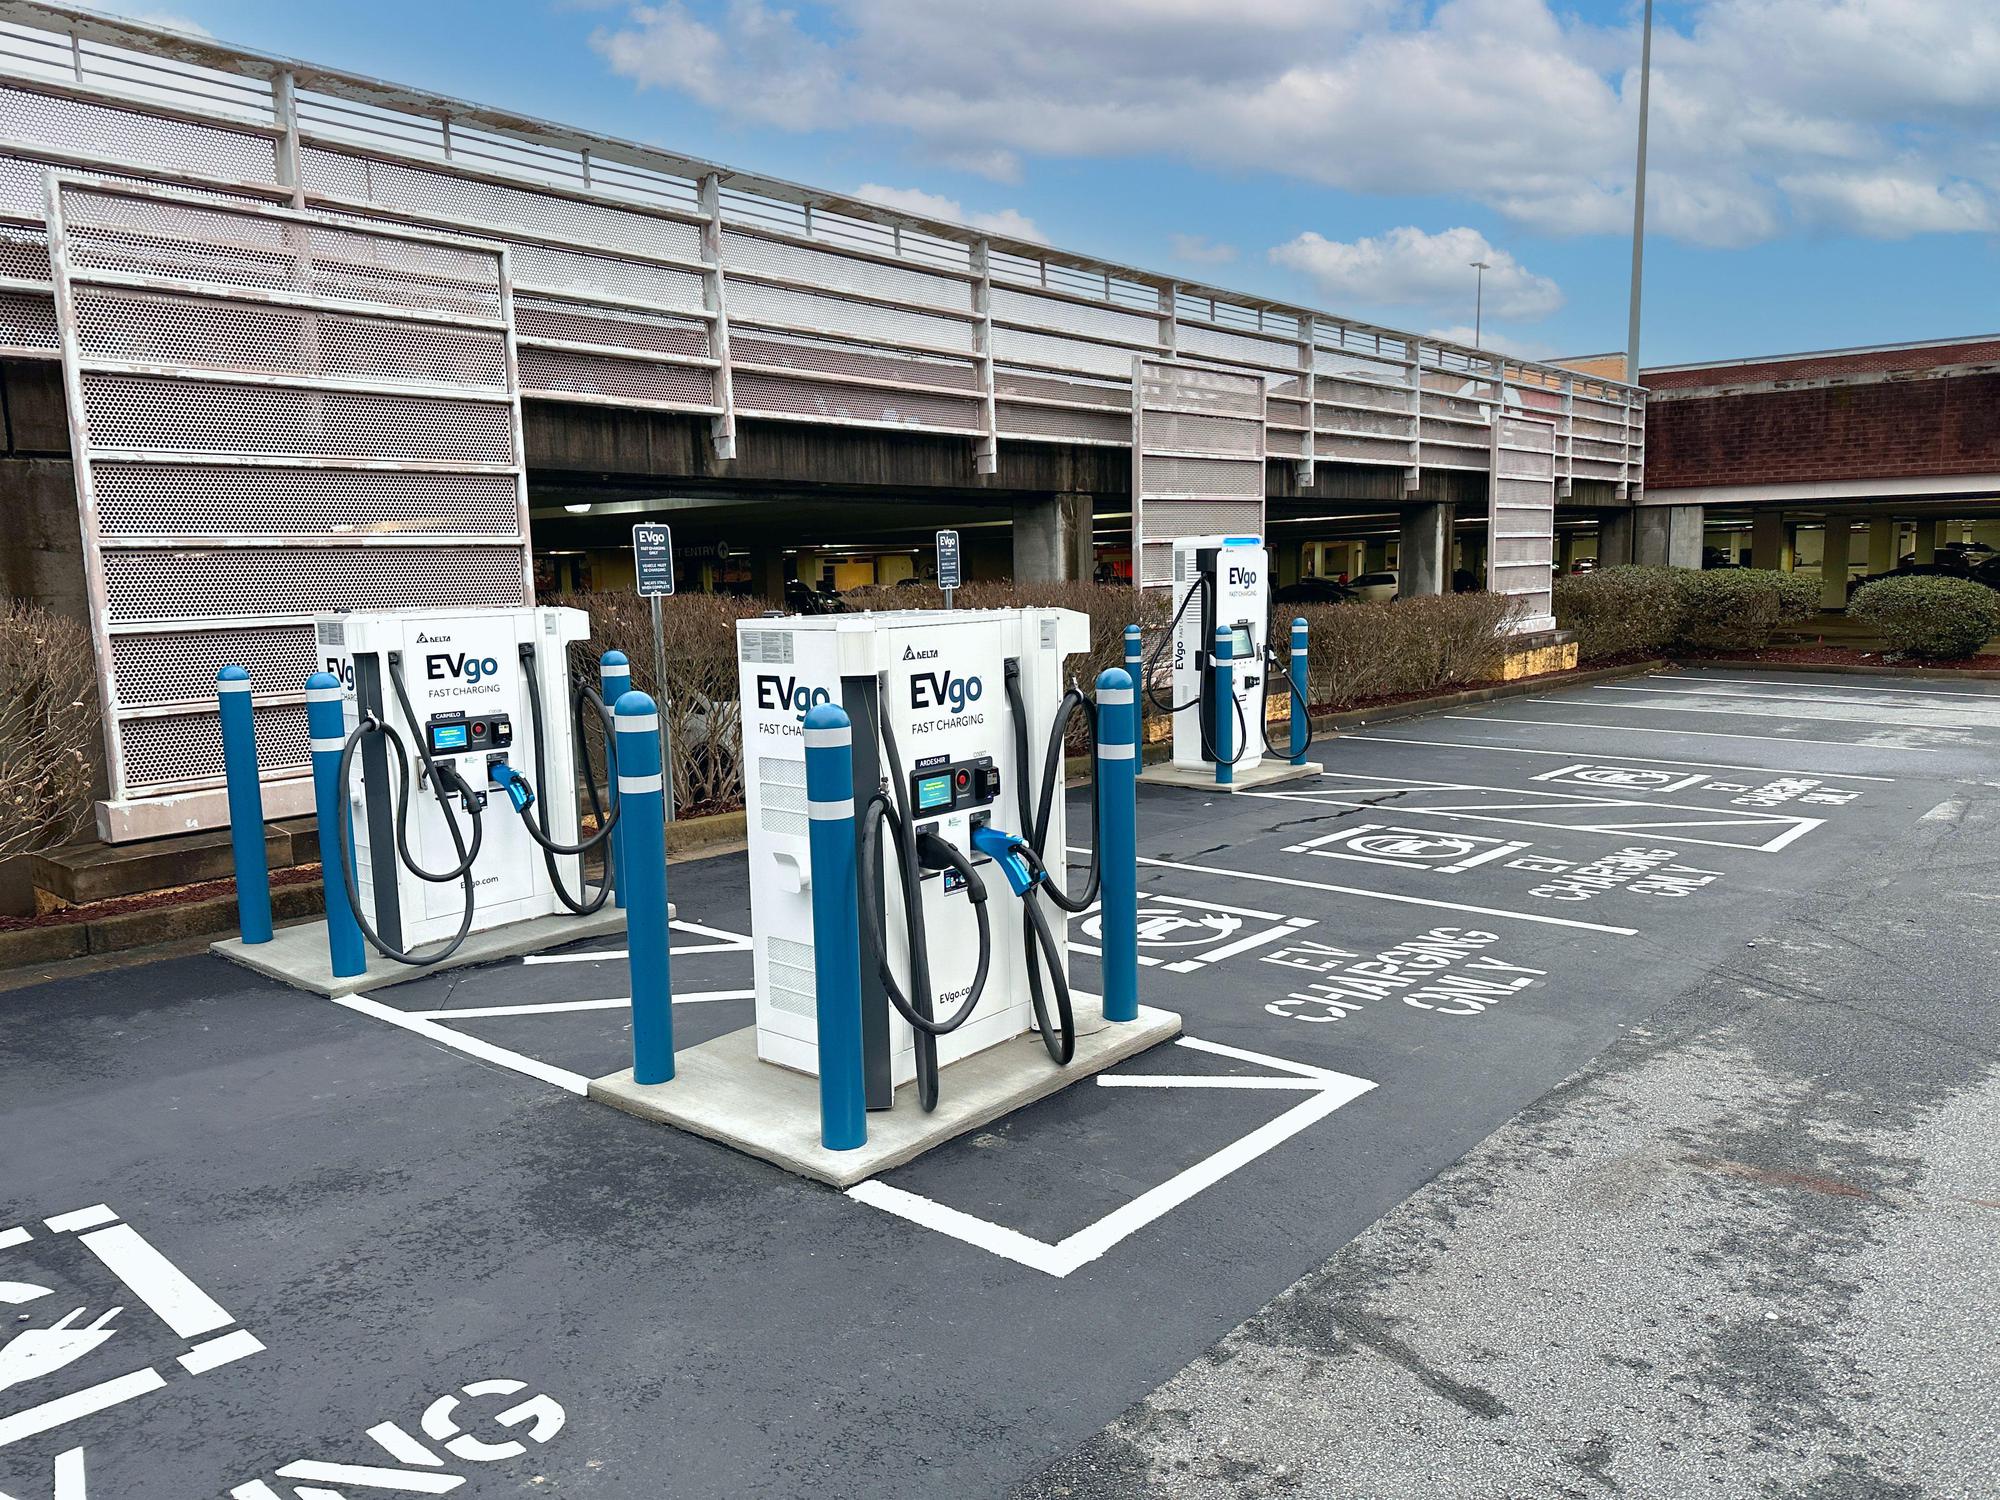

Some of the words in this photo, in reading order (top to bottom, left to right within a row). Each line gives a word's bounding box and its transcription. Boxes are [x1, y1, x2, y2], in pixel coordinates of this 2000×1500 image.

[639, 531, 665, 545] EVgo
[940, 536, 956, 548] EVgo
[685, 545, 715, 557] ENTRY
[1229, 567, 1257, 589] EVgo
[429, 635, 451, 643] DELTA
[917, 649, 939, 659] DELTA
[1175, 641, 1185, 670] EVgo
[326, 658, 355, 691] EVg
[426, 653, 498, 684] EVgo
[428, 688, 451, 698] FAST
[452, 684, 501, 696] CHARGING
[757, 675, 830, 722] EVgo
[910, 670, 982, 713] EVgo
[435, 711, 461, 720] CARMELO
[911, 720, 935, 735] FAST
[936, 713, 984, 731] CHARGING
[759, 722, 780, 735] FAST
[782, 724, 804, 737] CHA
[919, 756, 946, 767] ARDESHIR
[1503, 855, 1579, 873] EV
[1528, 847, 1679, 901] CHARGING
[460, 876, 499, 889] Ego.com
[1626, 864, 1726, 897] ONLY
[1258, 940, 1360, 972] EV
[1264, 927, 1500, 1023] CHARGING
[939, 986, 973, 1004] EVgo.co
[1402, 956, 1549, 1015] ONLY
